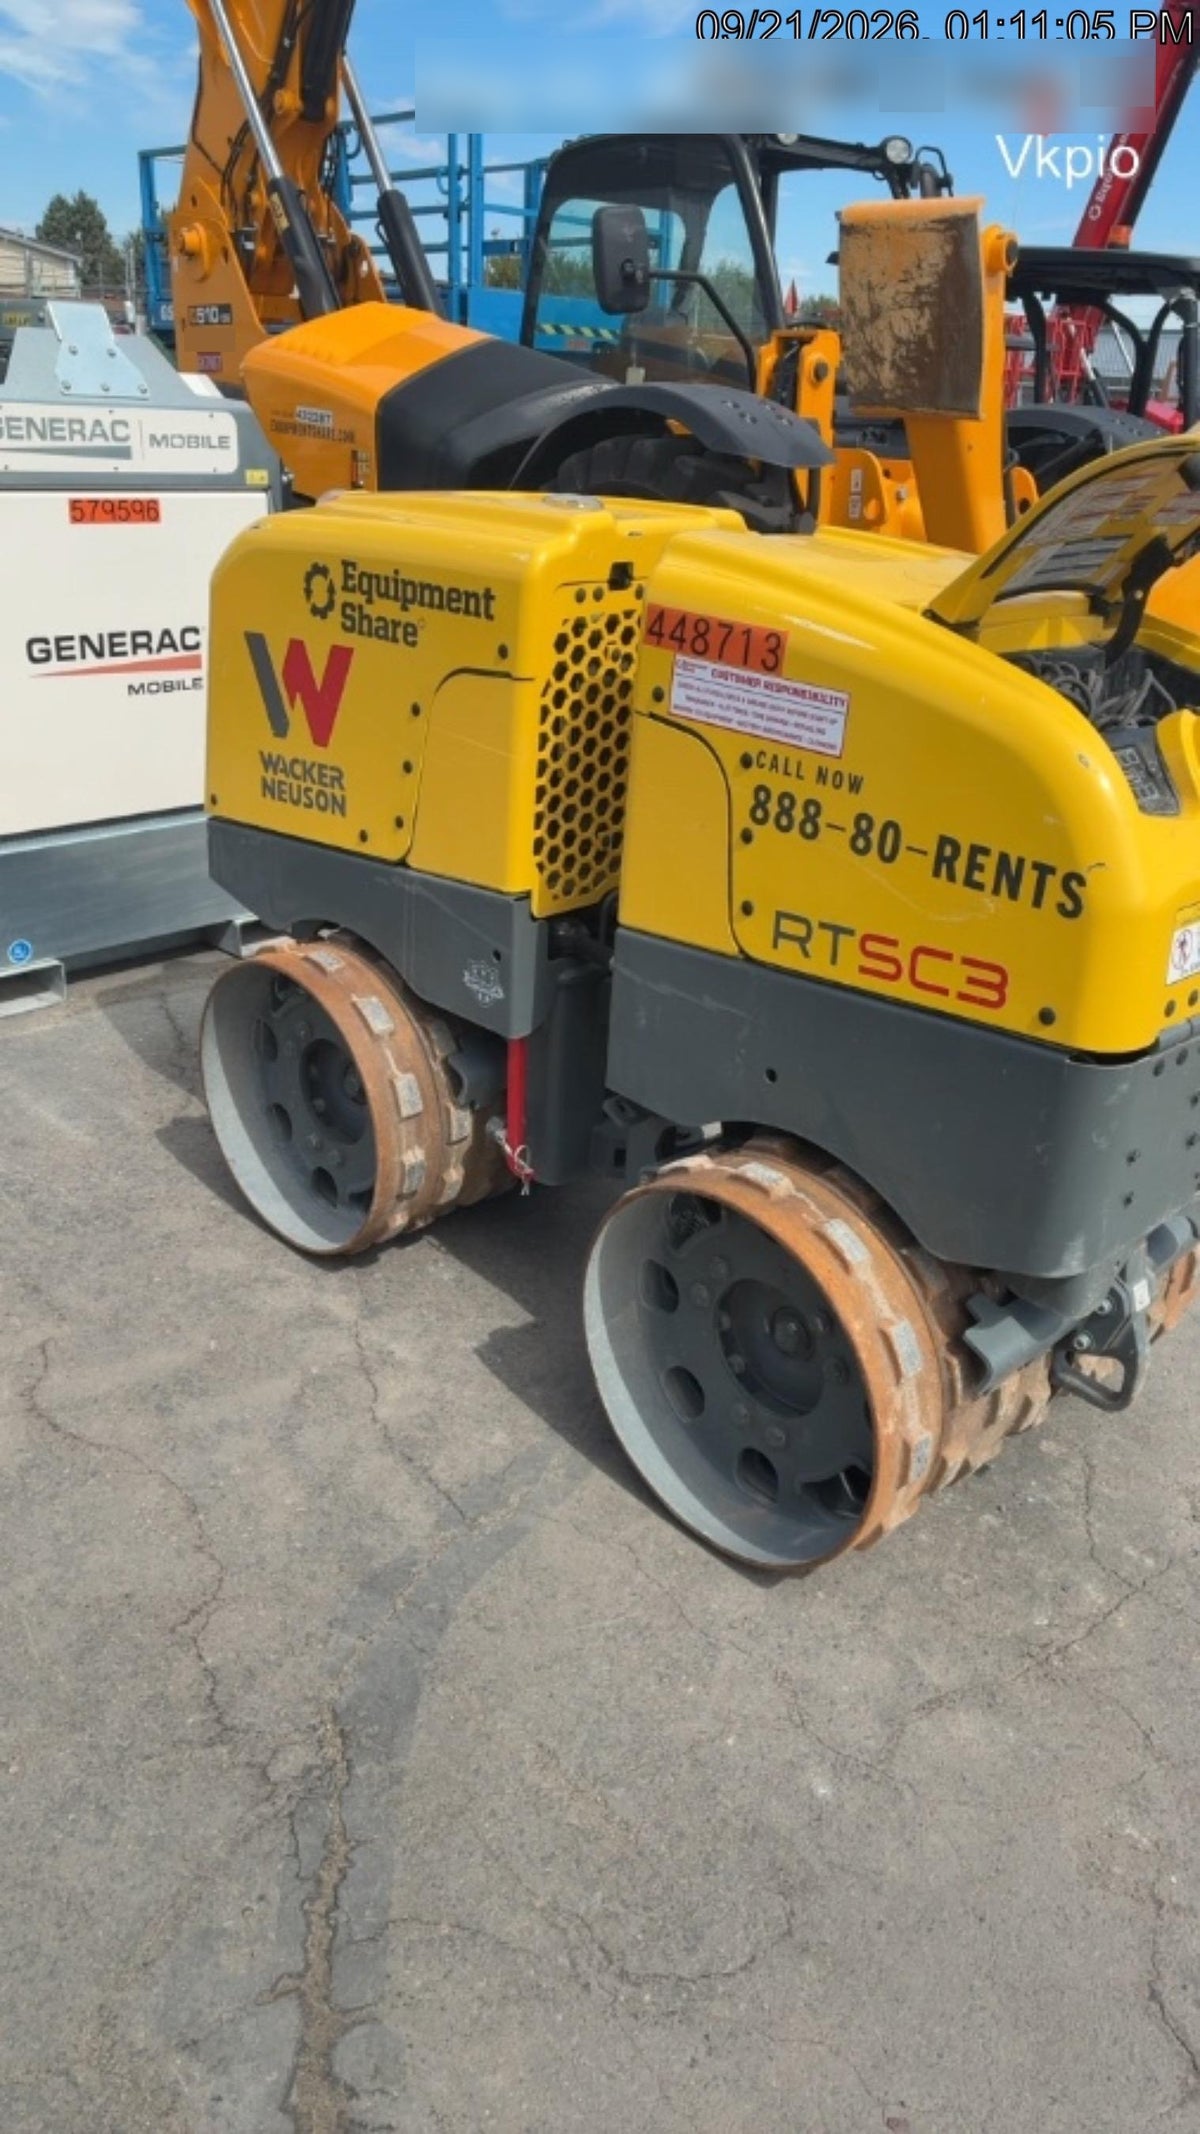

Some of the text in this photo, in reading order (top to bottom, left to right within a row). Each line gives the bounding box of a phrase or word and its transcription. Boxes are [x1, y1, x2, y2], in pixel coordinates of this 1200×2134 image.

[0, 416, 231, 449] ENERAC MOBILE
[71, 499, 160, 522] 579596
[341, 559, 496, 621] Equipment
[26, 626, 201, 664] GENERAC
[341, 601, 419, 648] Share
[646, 608, 781, 672] 448713
[127, 678, 204, 696] MOBILE
[259, 750, 345, 791] WACKER
[756, 750, 864, 795] CALL NOW
[261, 776, 347, 818] NEUSON
[749, 784, 1087, 919] 888-80-RENTS
